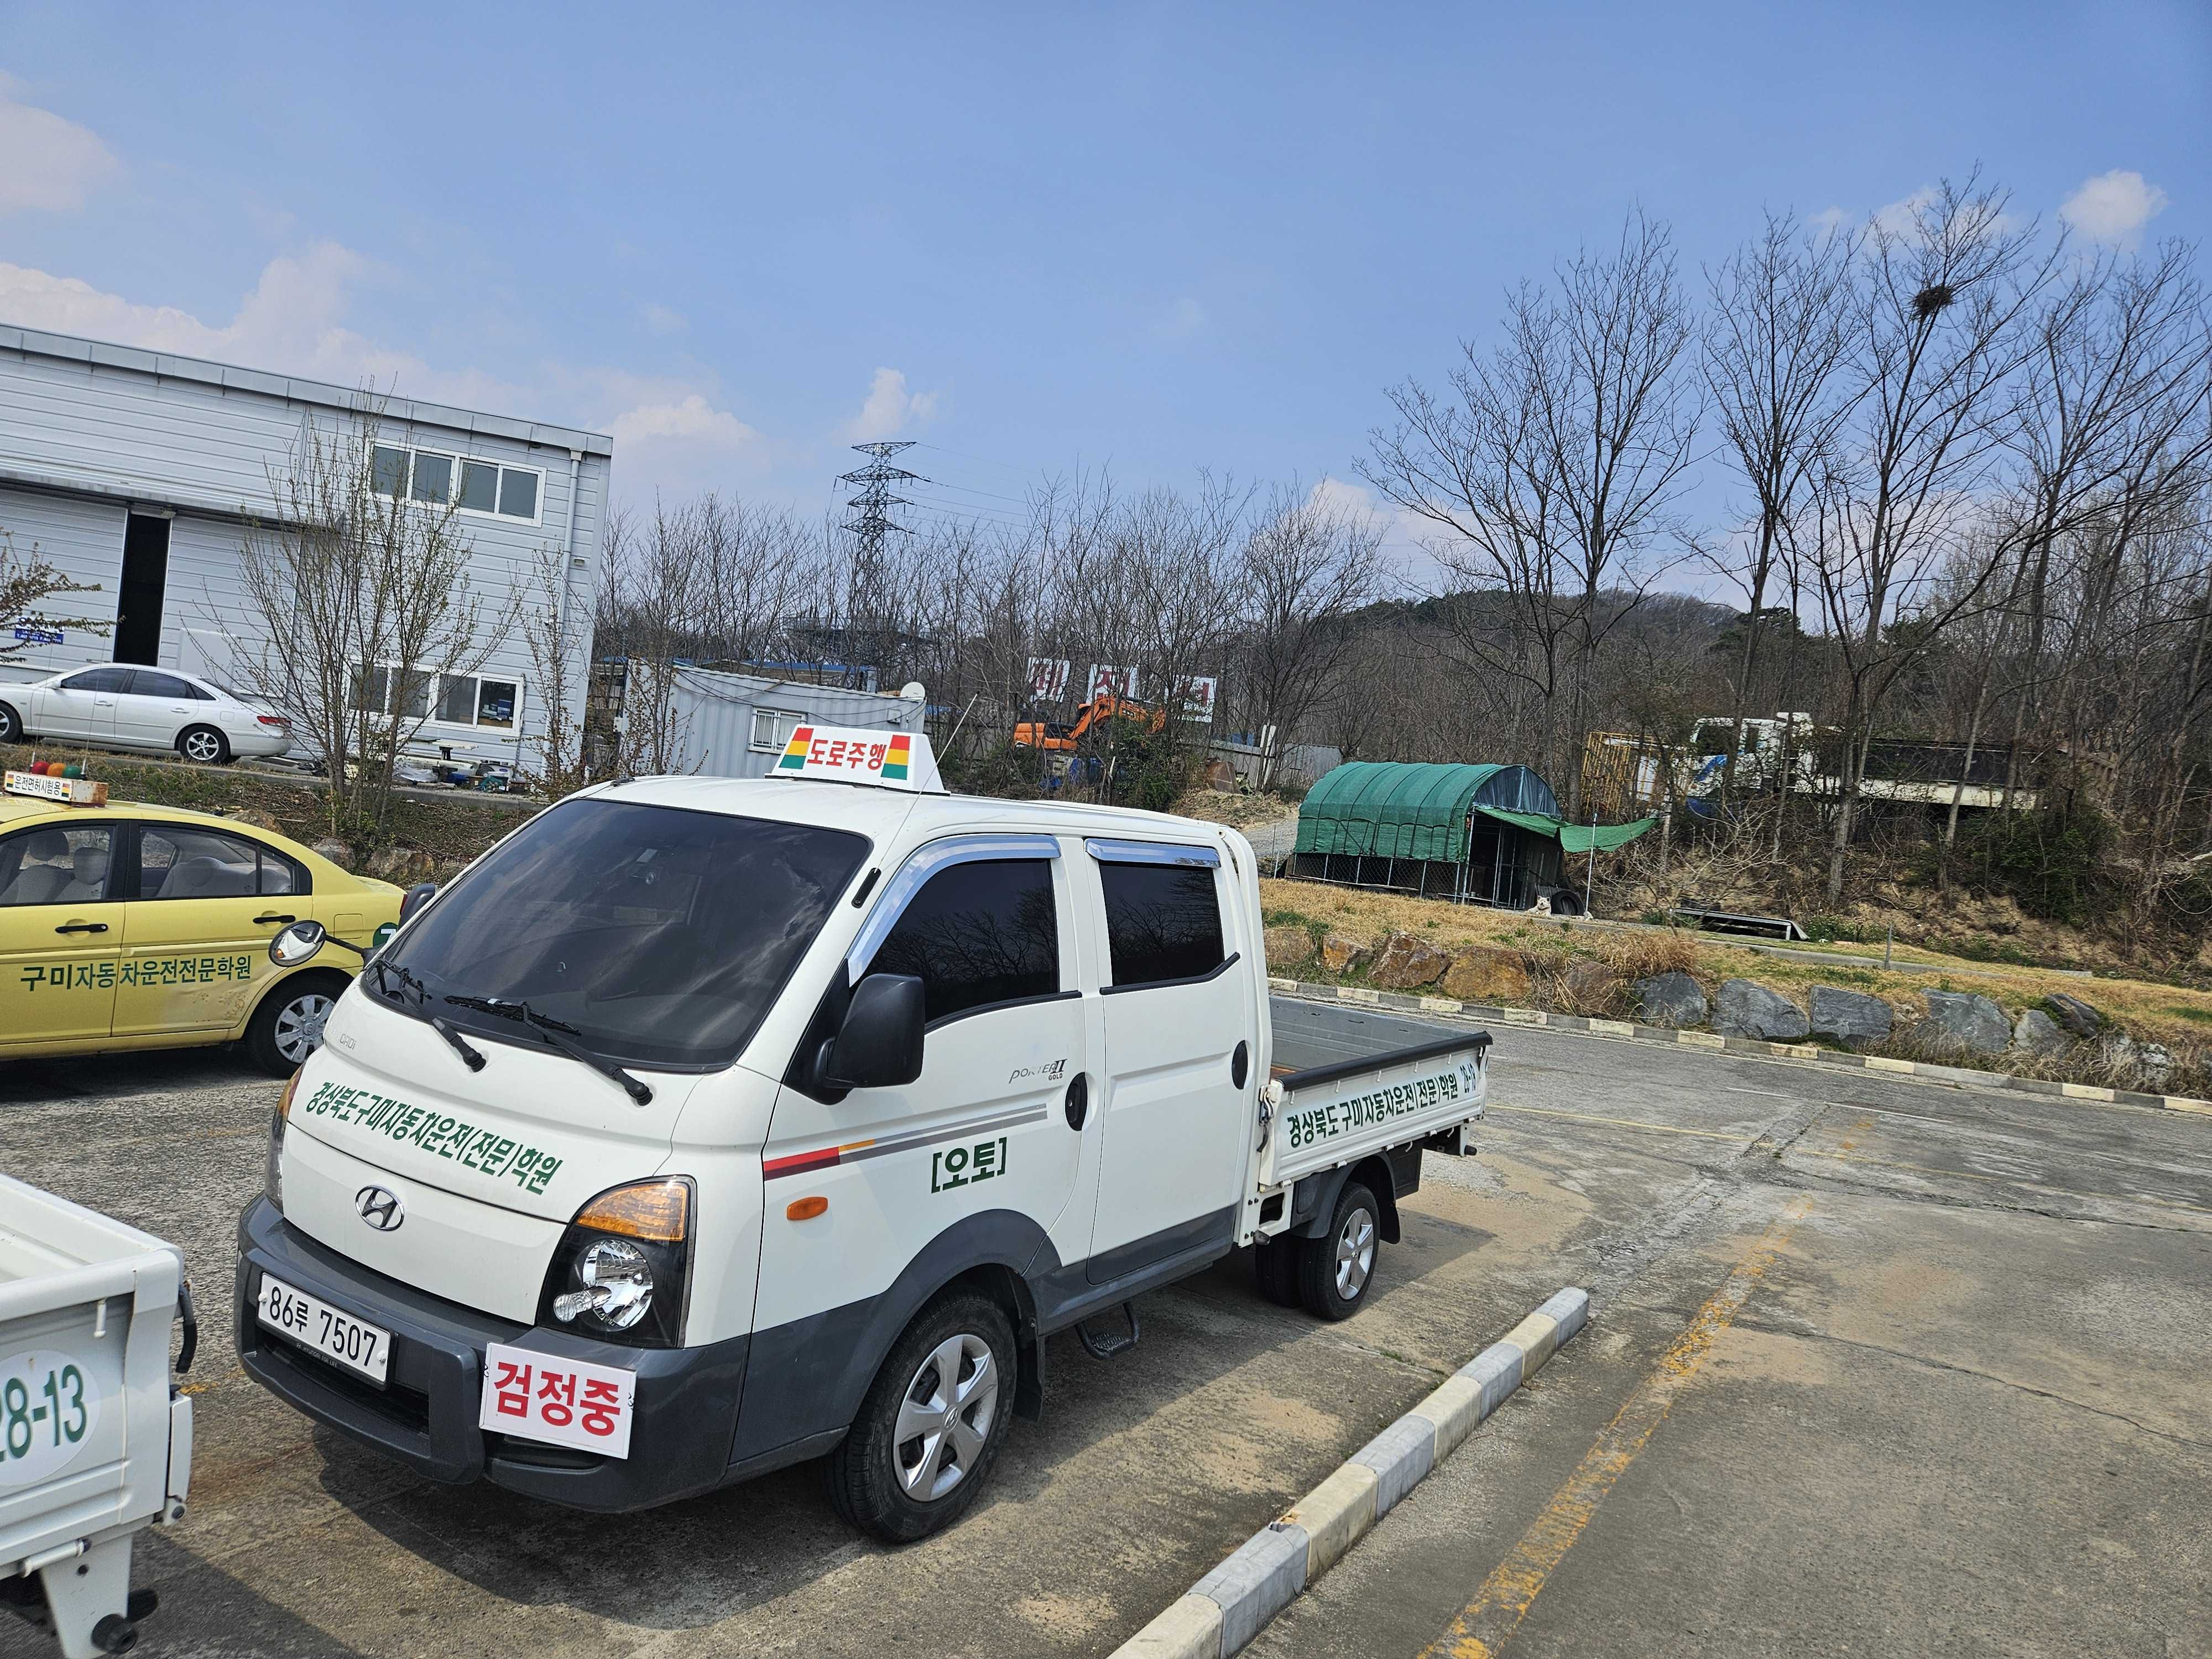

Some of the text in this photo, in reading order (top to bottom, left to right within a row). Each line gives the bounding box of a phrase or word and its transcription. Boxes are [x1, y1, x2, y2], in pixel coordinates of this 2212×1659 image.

[807, 739, 887, 770] 도로주행
[14, 775, 61, 795] 운전면허시험용
[20, 955, 251, 991] 구미자동차운전전문학원
[270, 1286, 377, 1366] 86루 7507
[0, 1364, 87, 1463] 8-13
[494, 1361, 620, 1436] 검정중
